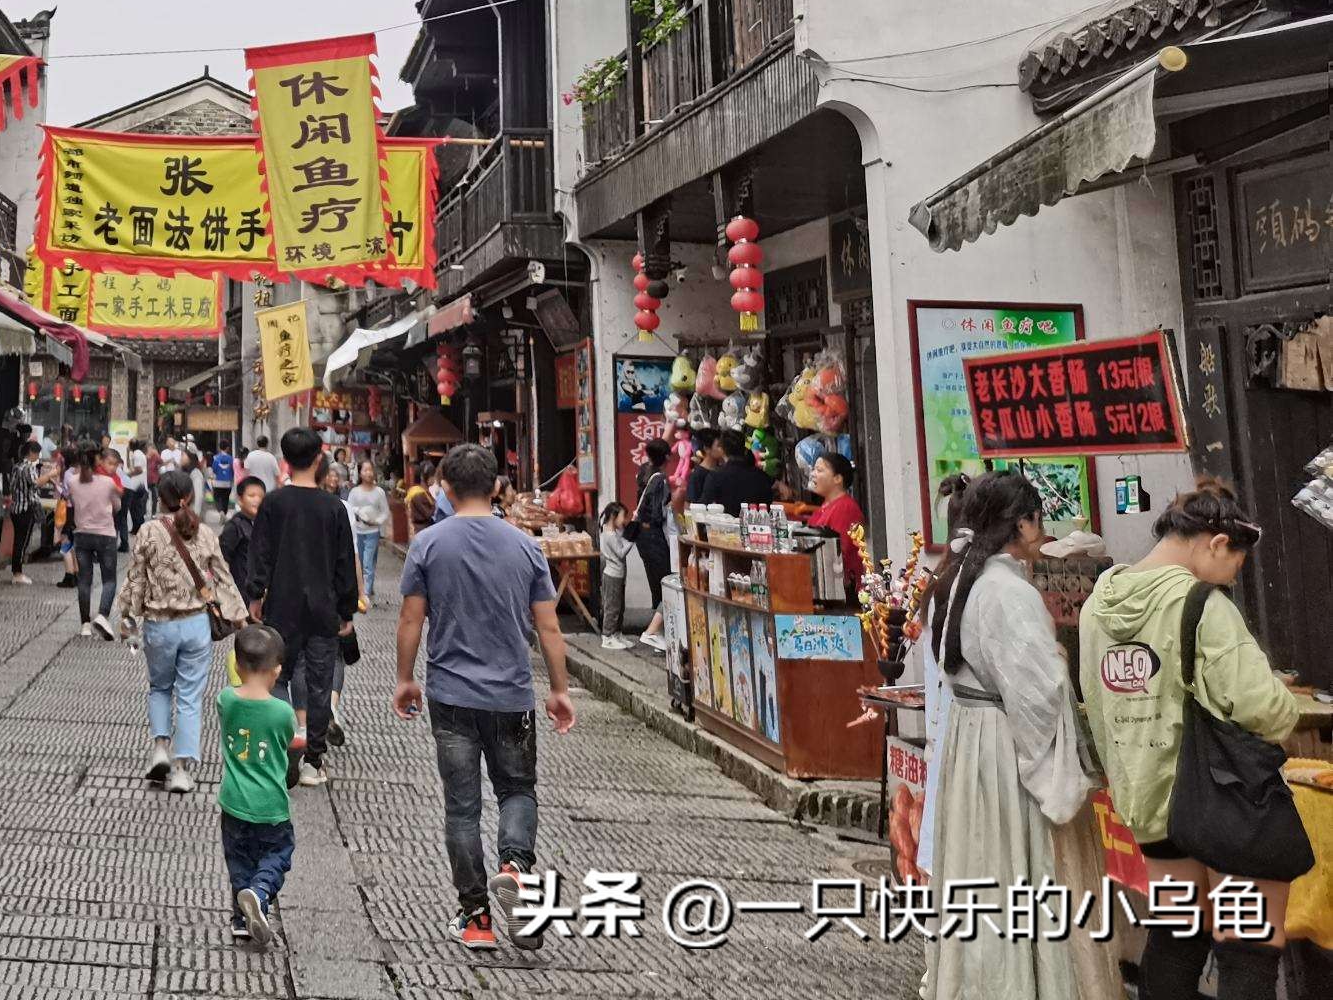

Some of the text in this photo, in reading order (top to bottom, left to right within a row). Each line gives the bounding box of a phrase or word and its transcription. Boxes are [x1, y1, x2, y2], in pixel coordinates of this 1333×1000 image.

[279, 71, 362, 234] 休闲鱼疗
[160, 156, 214, 196] 张
[285, 237, 386, 263] 环境一流
[974, 358, 1088, 403] 老长沙大香肠
[980, 400, 1097, 441] 冬瓜山小香肠
